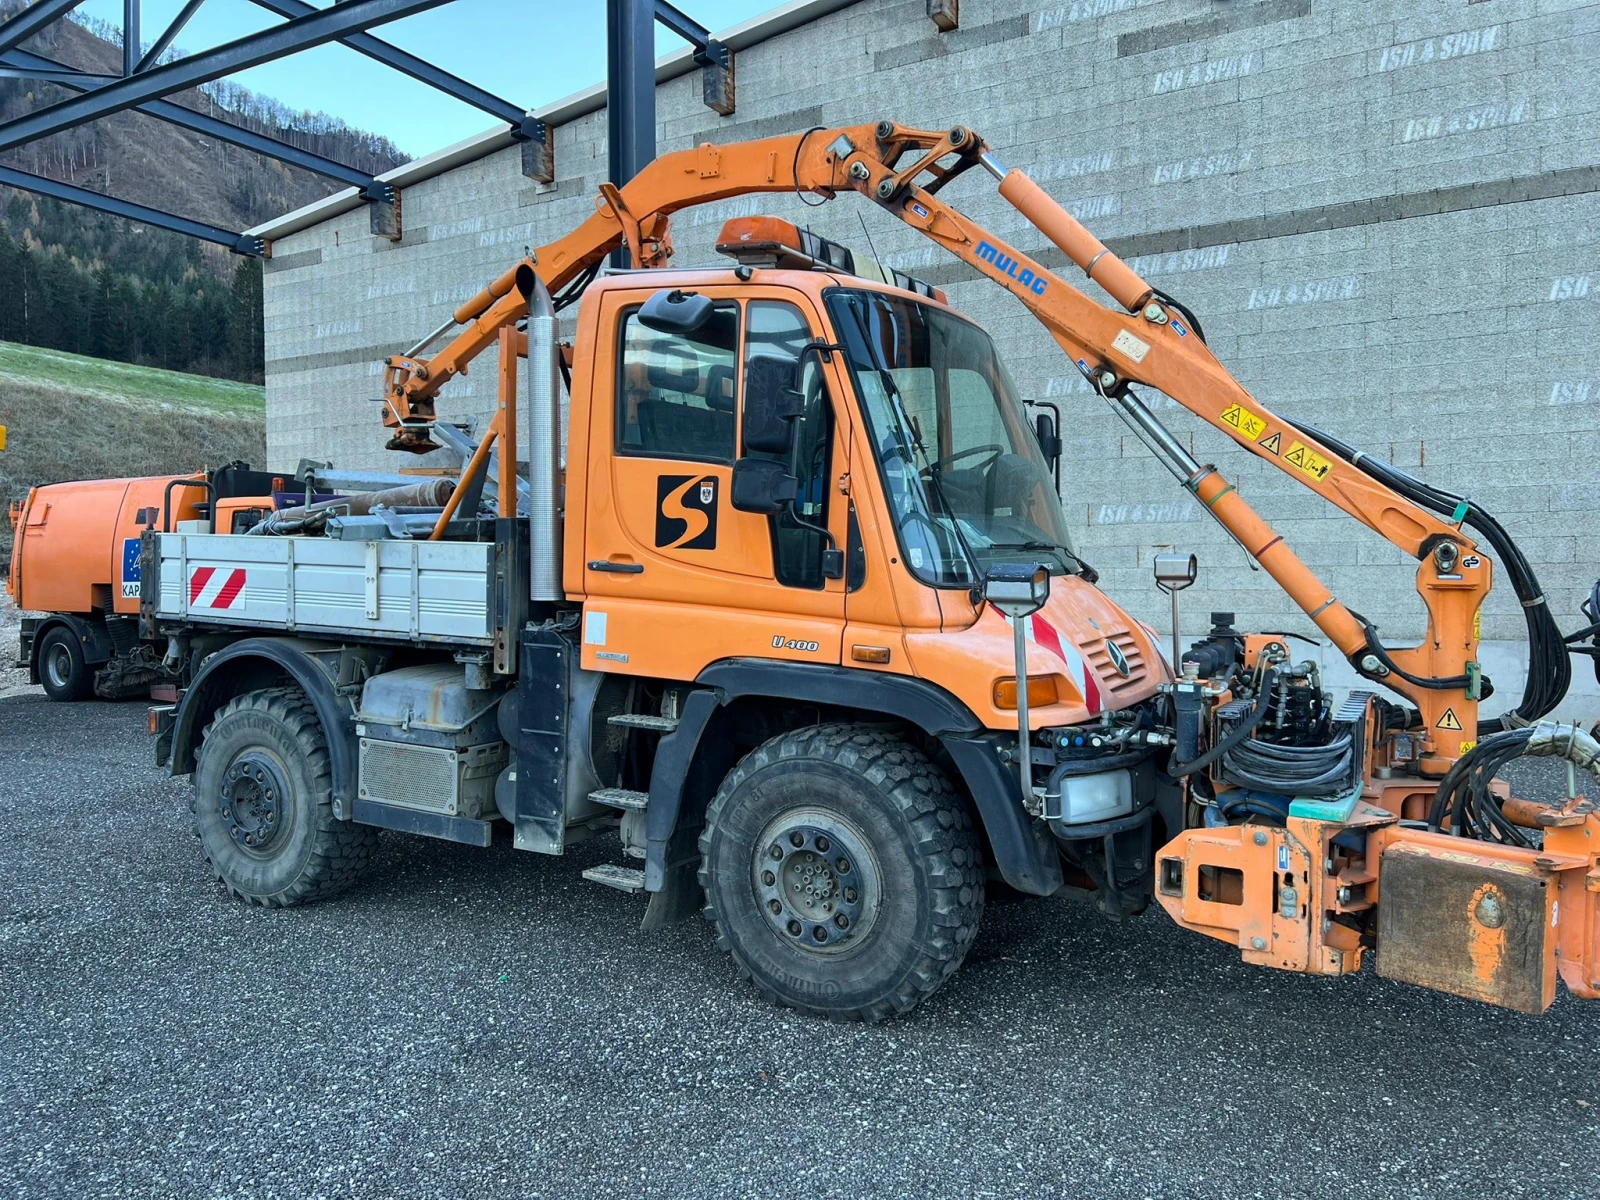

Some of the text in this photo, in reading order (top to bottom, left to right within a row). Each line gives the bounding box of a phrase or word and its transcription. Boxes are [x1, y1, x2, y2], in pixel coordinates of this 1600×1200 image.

[975, 241, 1048, 296] MULAG
[122, 584, 141, 596] KAP
[771, 635, 819, 652] U 400
